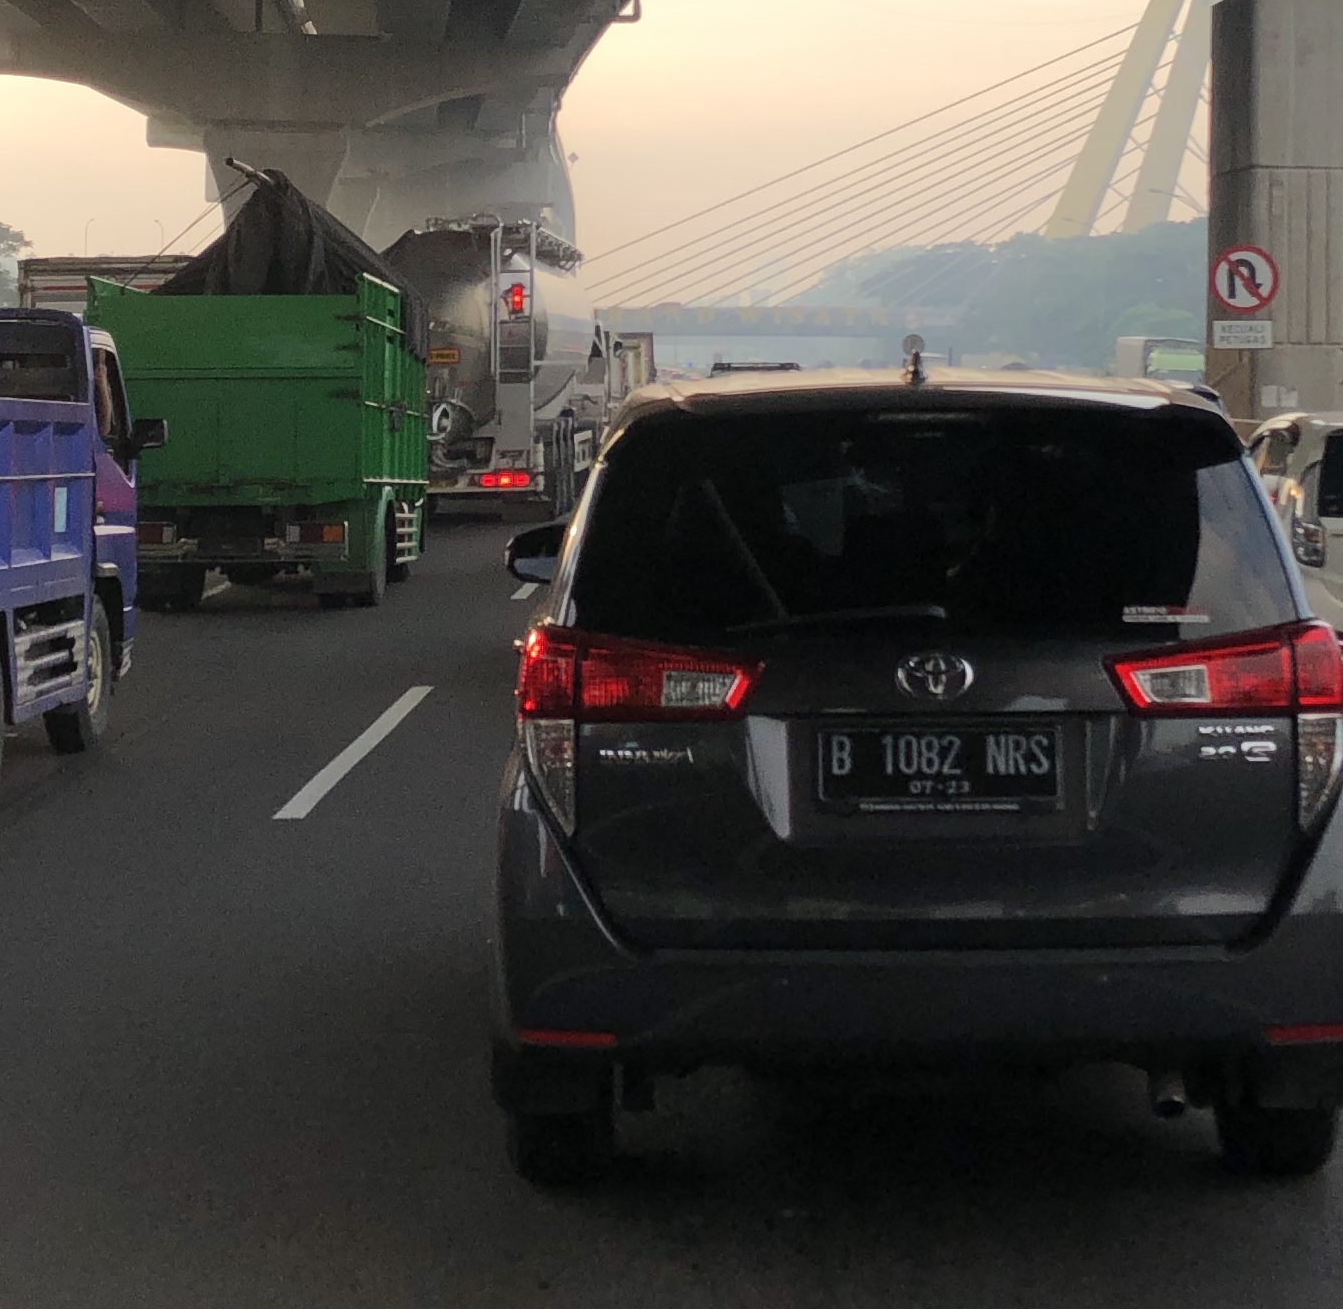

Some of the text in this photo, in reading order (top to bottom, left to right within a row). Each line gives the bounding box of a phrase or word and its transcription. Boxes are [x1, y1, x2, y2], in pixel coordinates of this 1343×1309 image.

[830, 734, 1052, 776] B 1082 NRS
